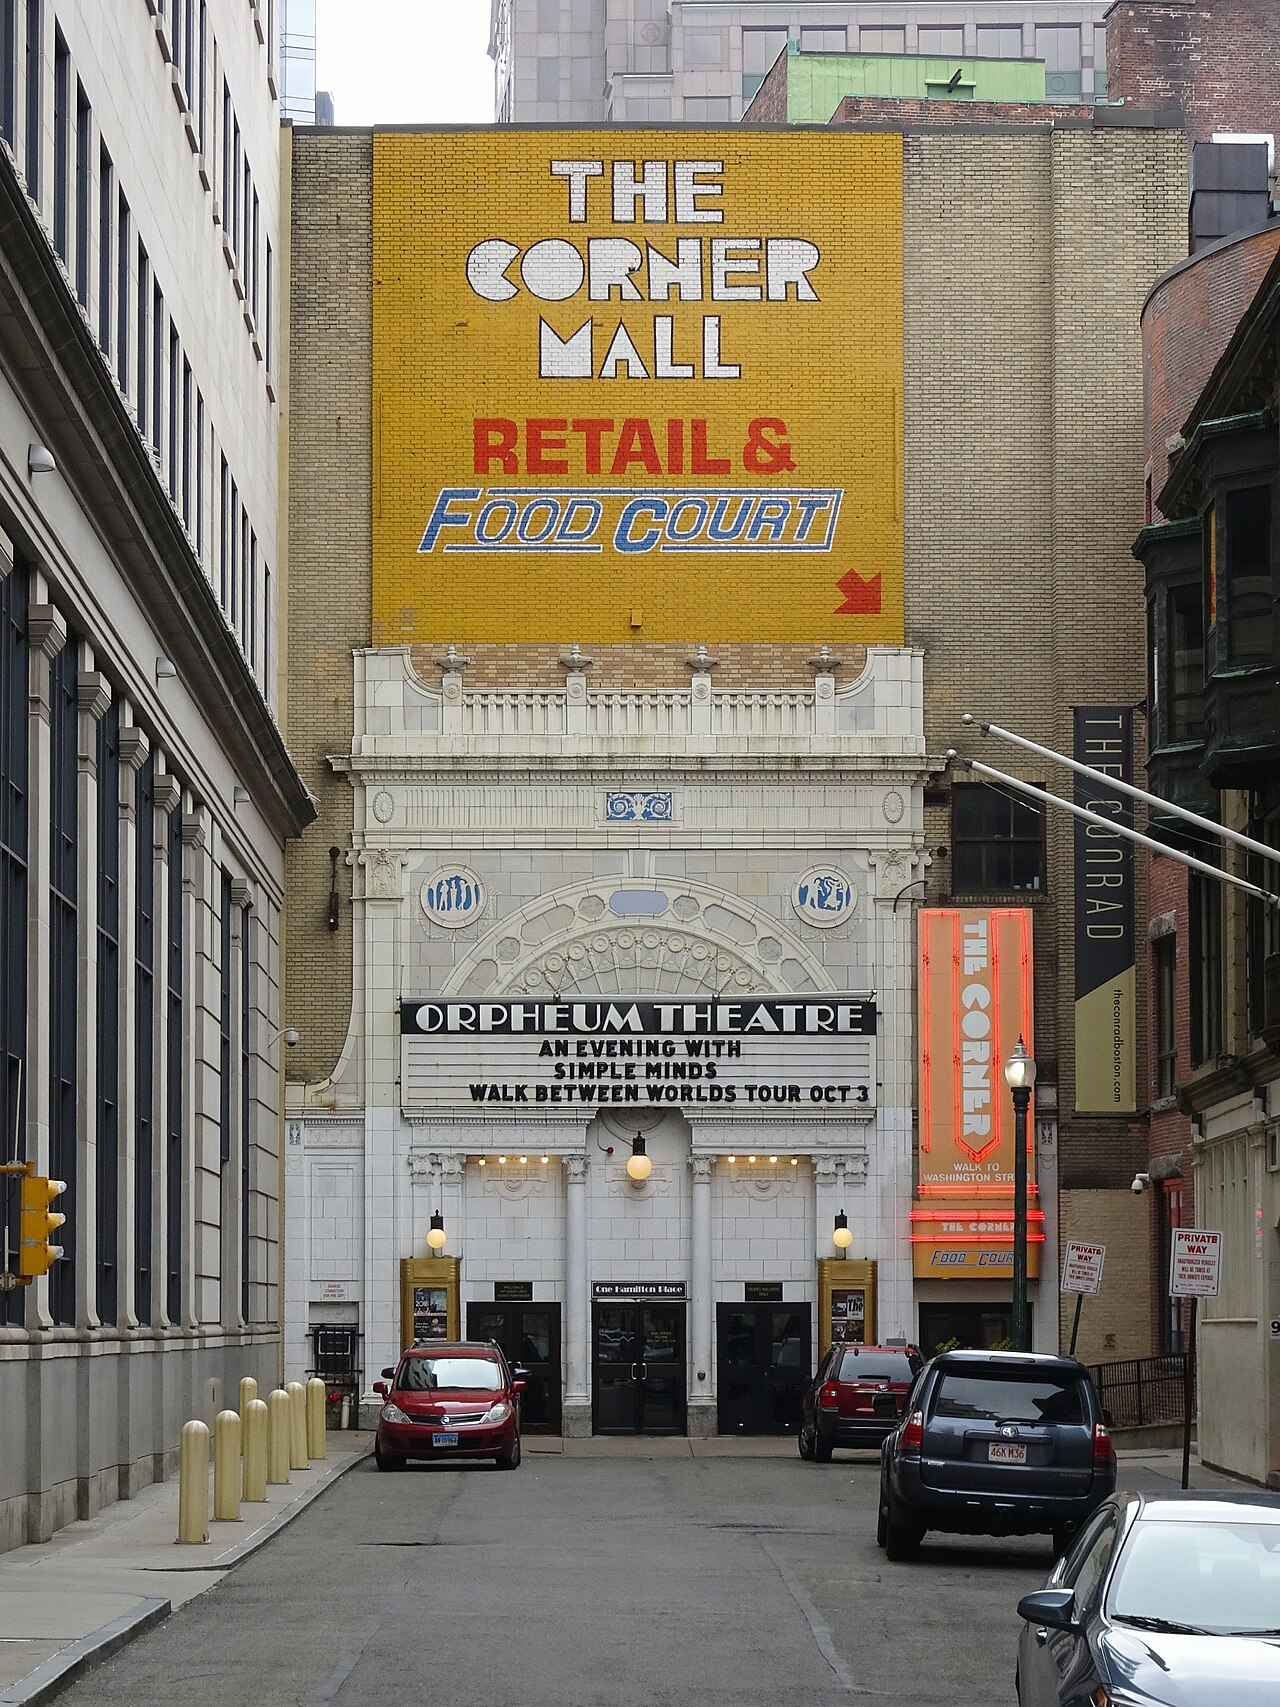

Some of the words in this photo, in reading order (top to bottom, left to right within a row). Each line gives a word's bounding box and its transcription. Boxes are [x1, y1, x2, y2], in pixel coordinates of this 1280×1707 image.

[550, 159, 725, 224] THE
[466, 237, 821, 302] CORNER
[538, 314, 742, 380] MALL
[472, 417, 731, 476] RETAIL
[742, 416, 797, 475] &
[416, 488, 603, 554] FOOD
[612, 496, 833, 554] COURT
[1085, 800, 1124, 939] CONRAD
[963, 919, 987, 975] THE
[415, 1002, 644, 1032] ORPHEUM
[653, 1002, 863, 1032] THEATRE
[539, 1039, 569, 1057] AN
[576, 1039, 676, 1057] EVENING
[685, 1039, 741, 1057] WITH
[1113, 989, 1124, 1103] theconradboston.com
[961, 983, 991, 1136] CORNER
[553, 1062, 636, 1080] SIMPLE
[645, 1061, 717, 1079] MINDS
[469, 1084, 528, 1101] WALK
[535, 1084, 639, 1102] BETWEEN
[646, 1084, 737, 1102] WORLDS
[745, 1084, 801, 1102] TOUR
[810, 1085, 850, 1101] OCT
[856, 1085, 869, 1101] 3
[953, 1162, 982, 1171] WALK
[986, 1162, 1000, 1171] TO
[923, 1173, 991, 1182] WASHINGTON
[995, 1173, 1031, 1182] STRT
[942, 1222, 964, 1232] THE
[1177, 1233, 1218, 1244] PRIVATE
[978, 1250, 1014, 1266] COUR
[1071, 1244, 1102, 1255] PRIVATE
[1077, 1254, 1093, 1262] WAY
[1187, 1245, 1207, 1254] WAY
[595, 1285, 613, 1293] One
[615, 1285, 656, 1293] Hamilton
[658, 1285, 683, 1293] Place
[1271, 1320, 1280, 1334] 9
